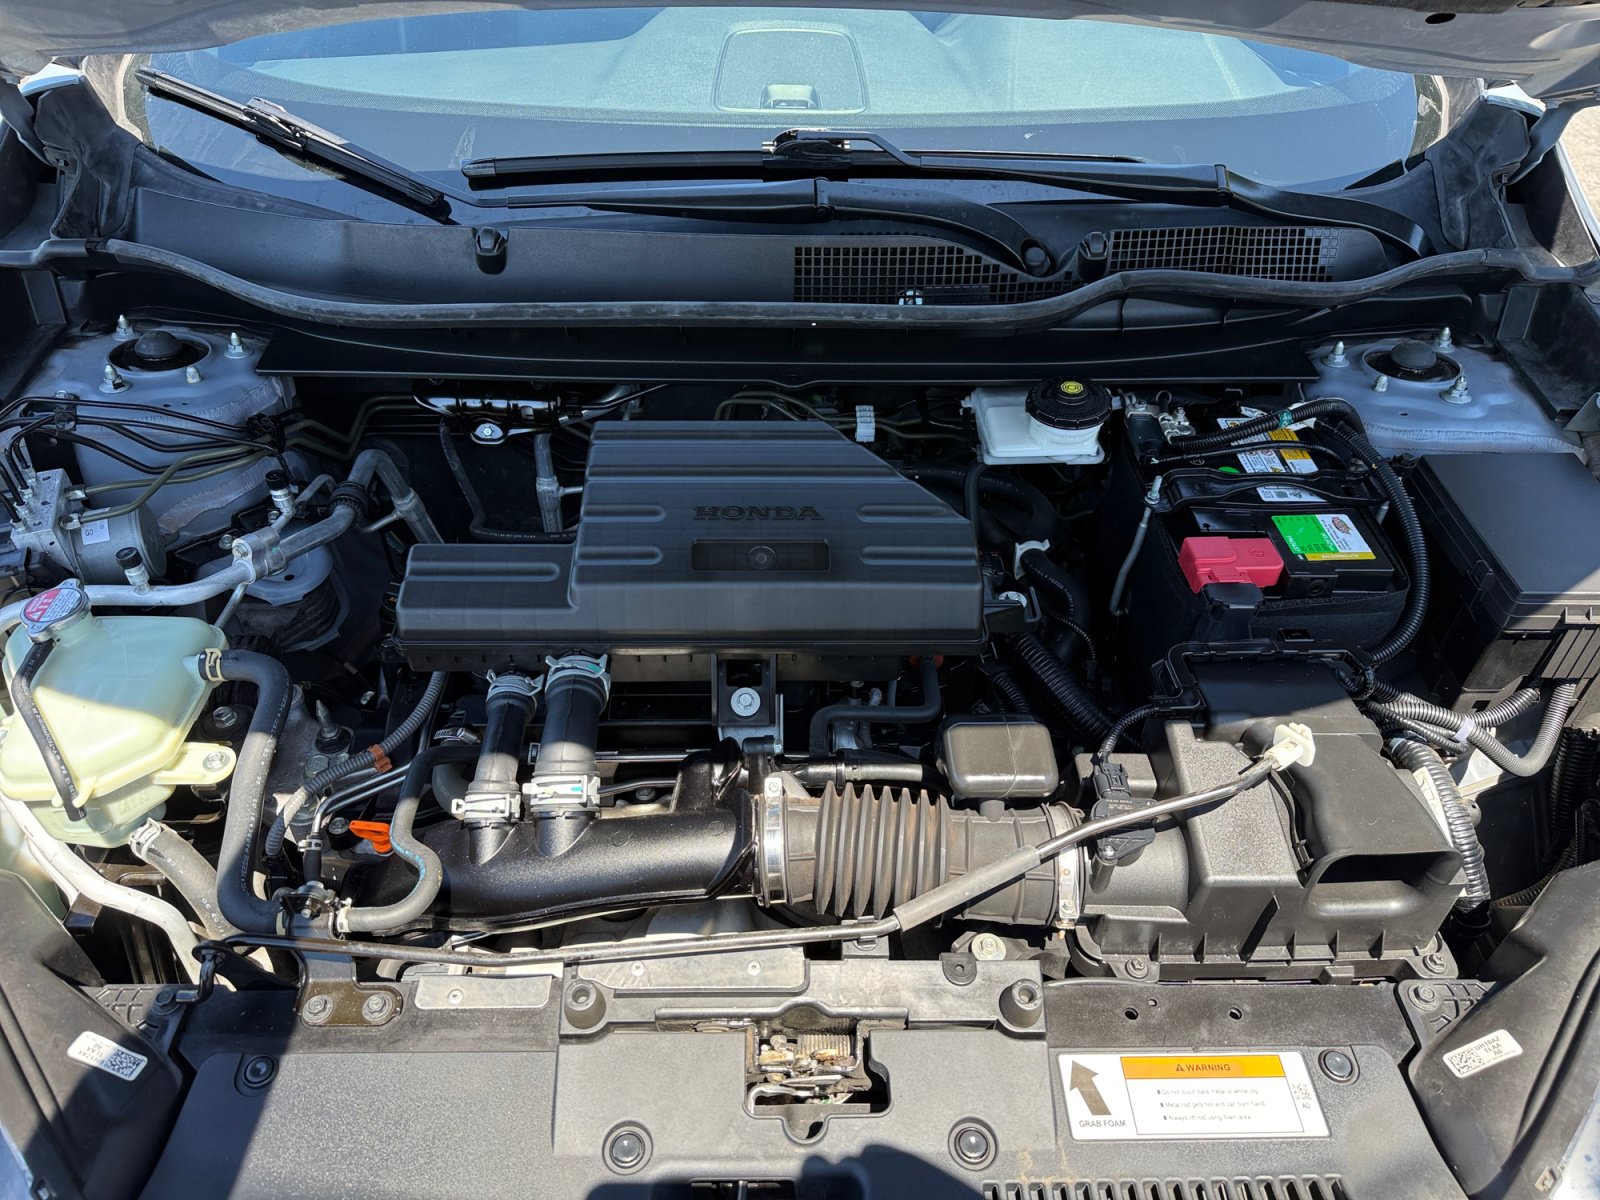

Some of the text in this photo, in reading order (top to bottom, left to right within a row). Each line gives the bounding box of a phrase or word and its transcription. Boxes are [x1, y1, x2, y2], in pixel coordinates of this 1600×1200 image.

[692, 505, 825, 521] HONDA
[1185, 1063, 1231, 1071] WARNING
[1078, 1119, 1126, 1127] GRAB FOAM
